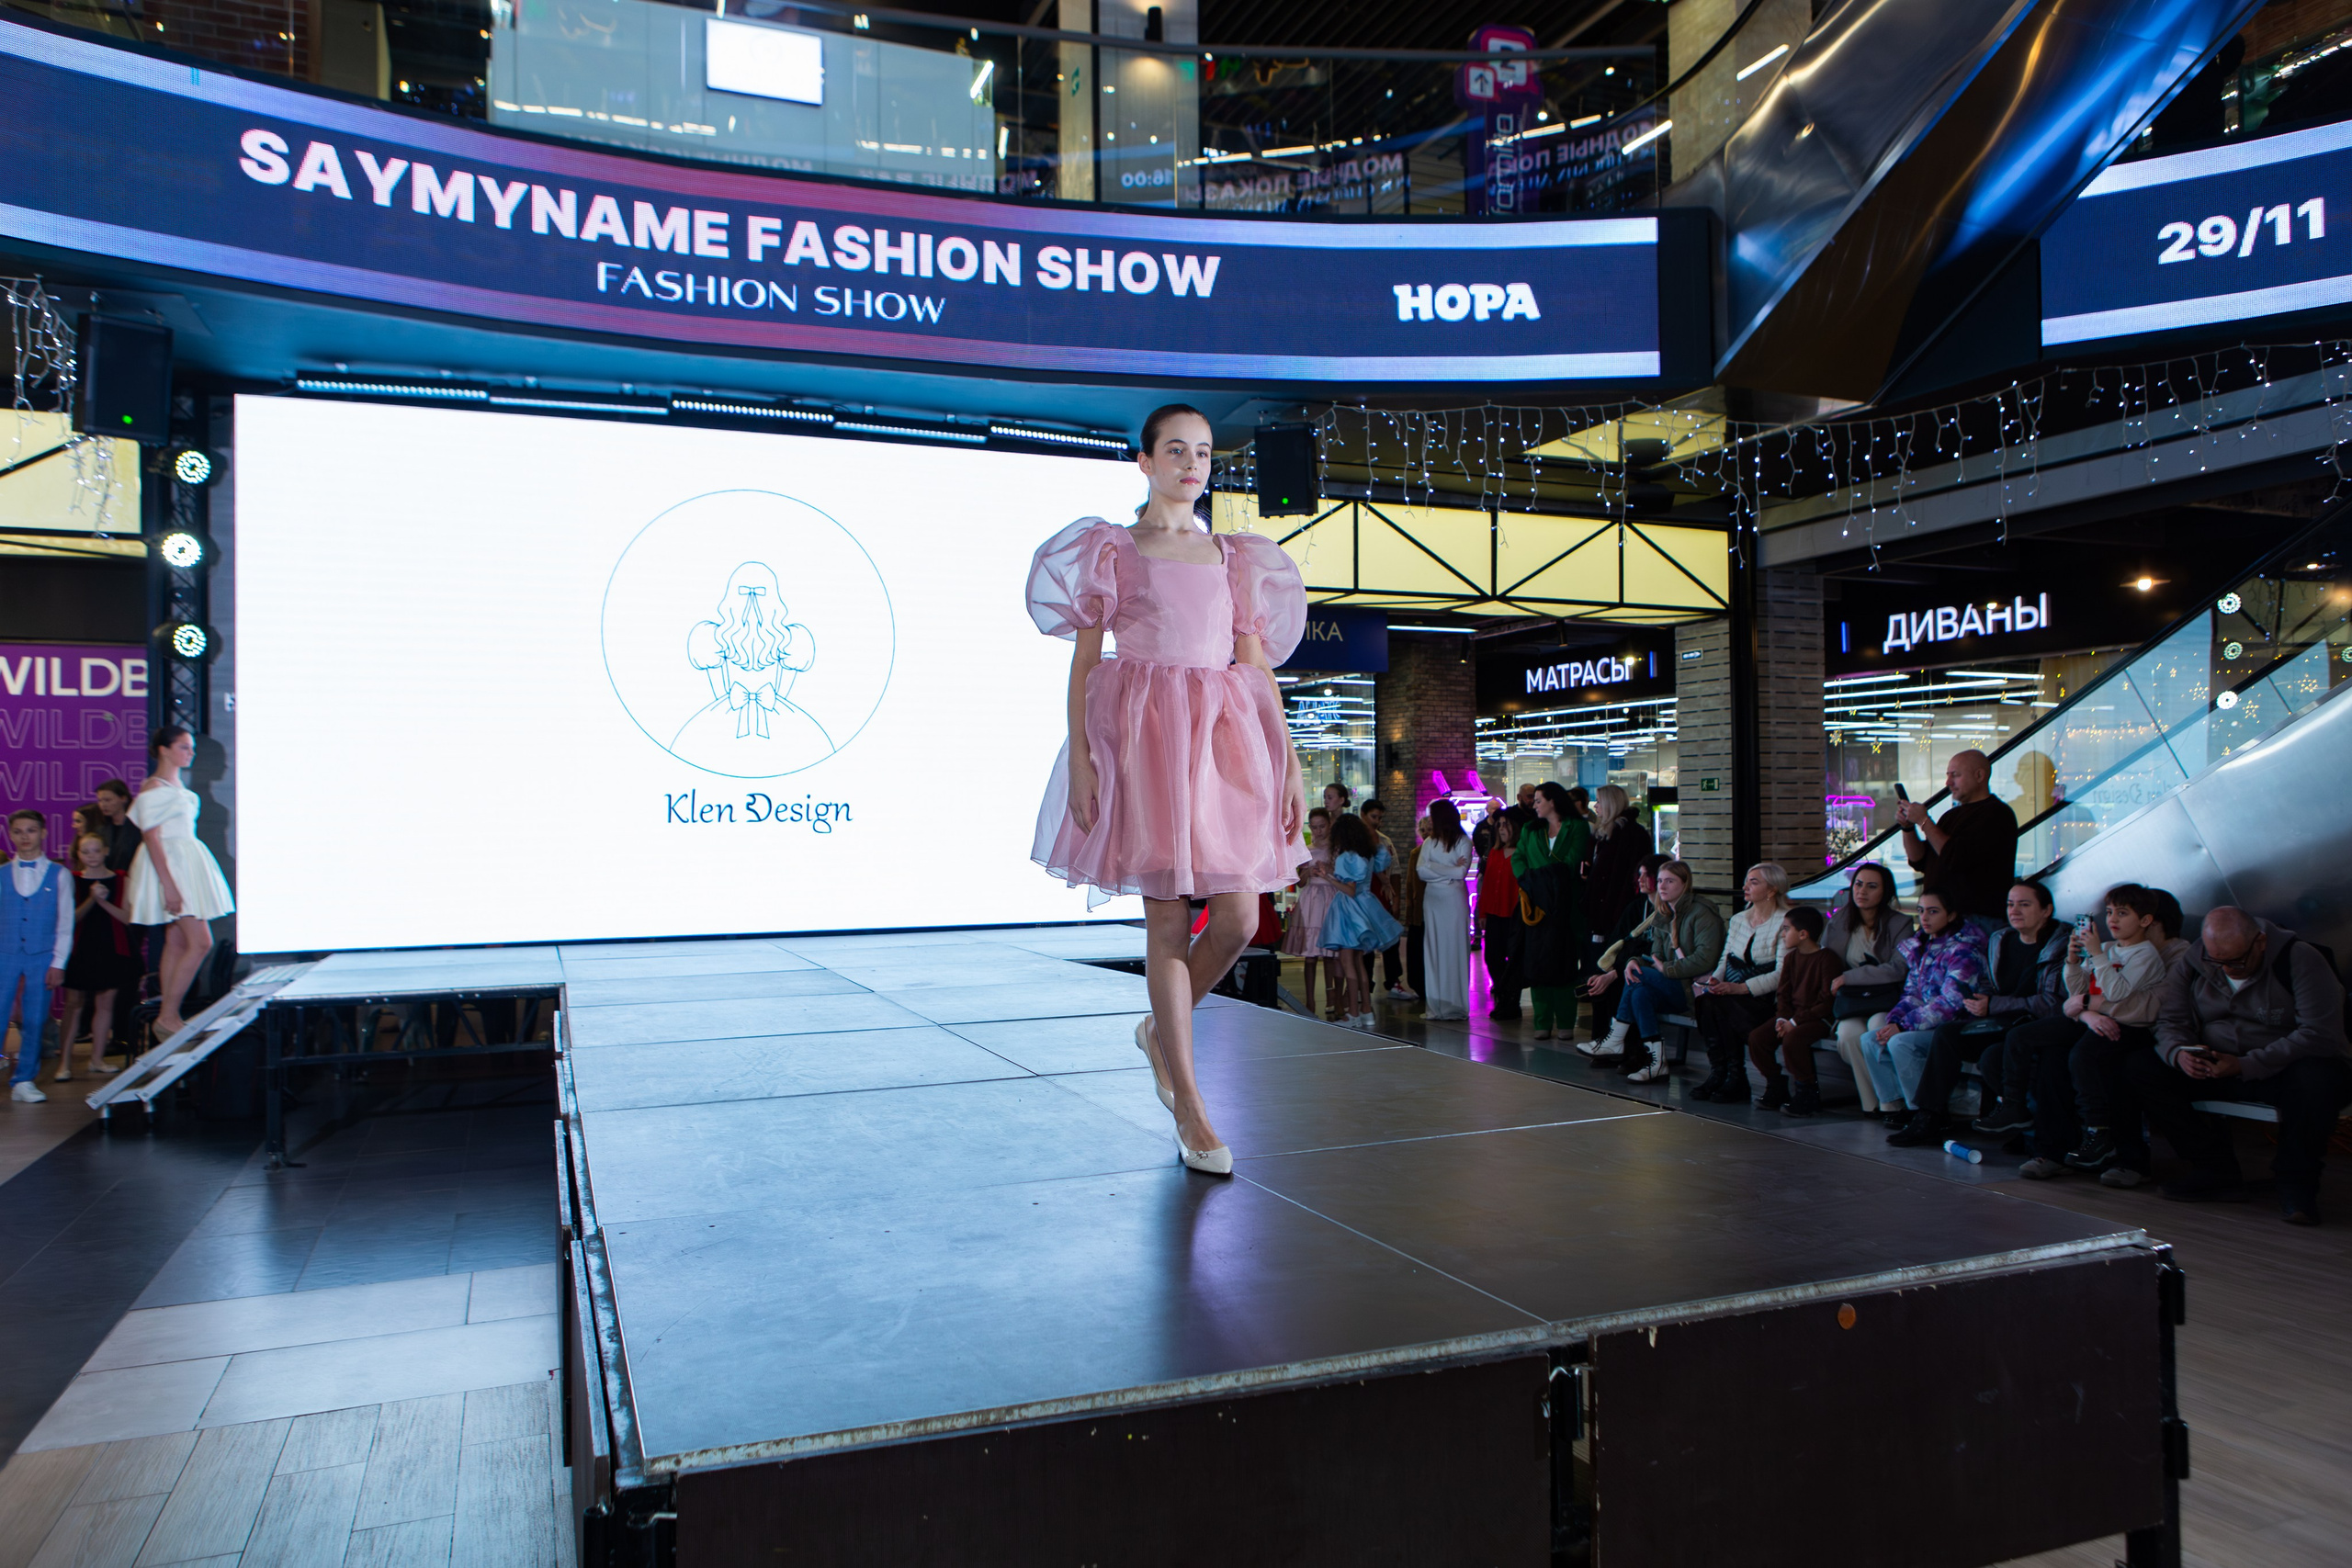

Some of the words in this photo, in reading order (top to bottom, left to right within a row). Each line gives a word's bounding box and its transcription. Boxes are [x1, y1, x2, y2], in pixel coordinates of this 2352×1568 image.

[240, 129, 730, 264] SAYMYNAME
[748, 215, 1022, 287] FASHION
[1036, 246, 1221, 299] SHOW
[2157, 197, 2325, 265] 29/11
[597, 261, 798, 312] FASHION
[814, 286, 946, 324] SHOW
[1526, 656, 1632, 693] МАТРАСЫ
[663, 788, 737, 825] Klen
[745, 794, 854, 834] Design
